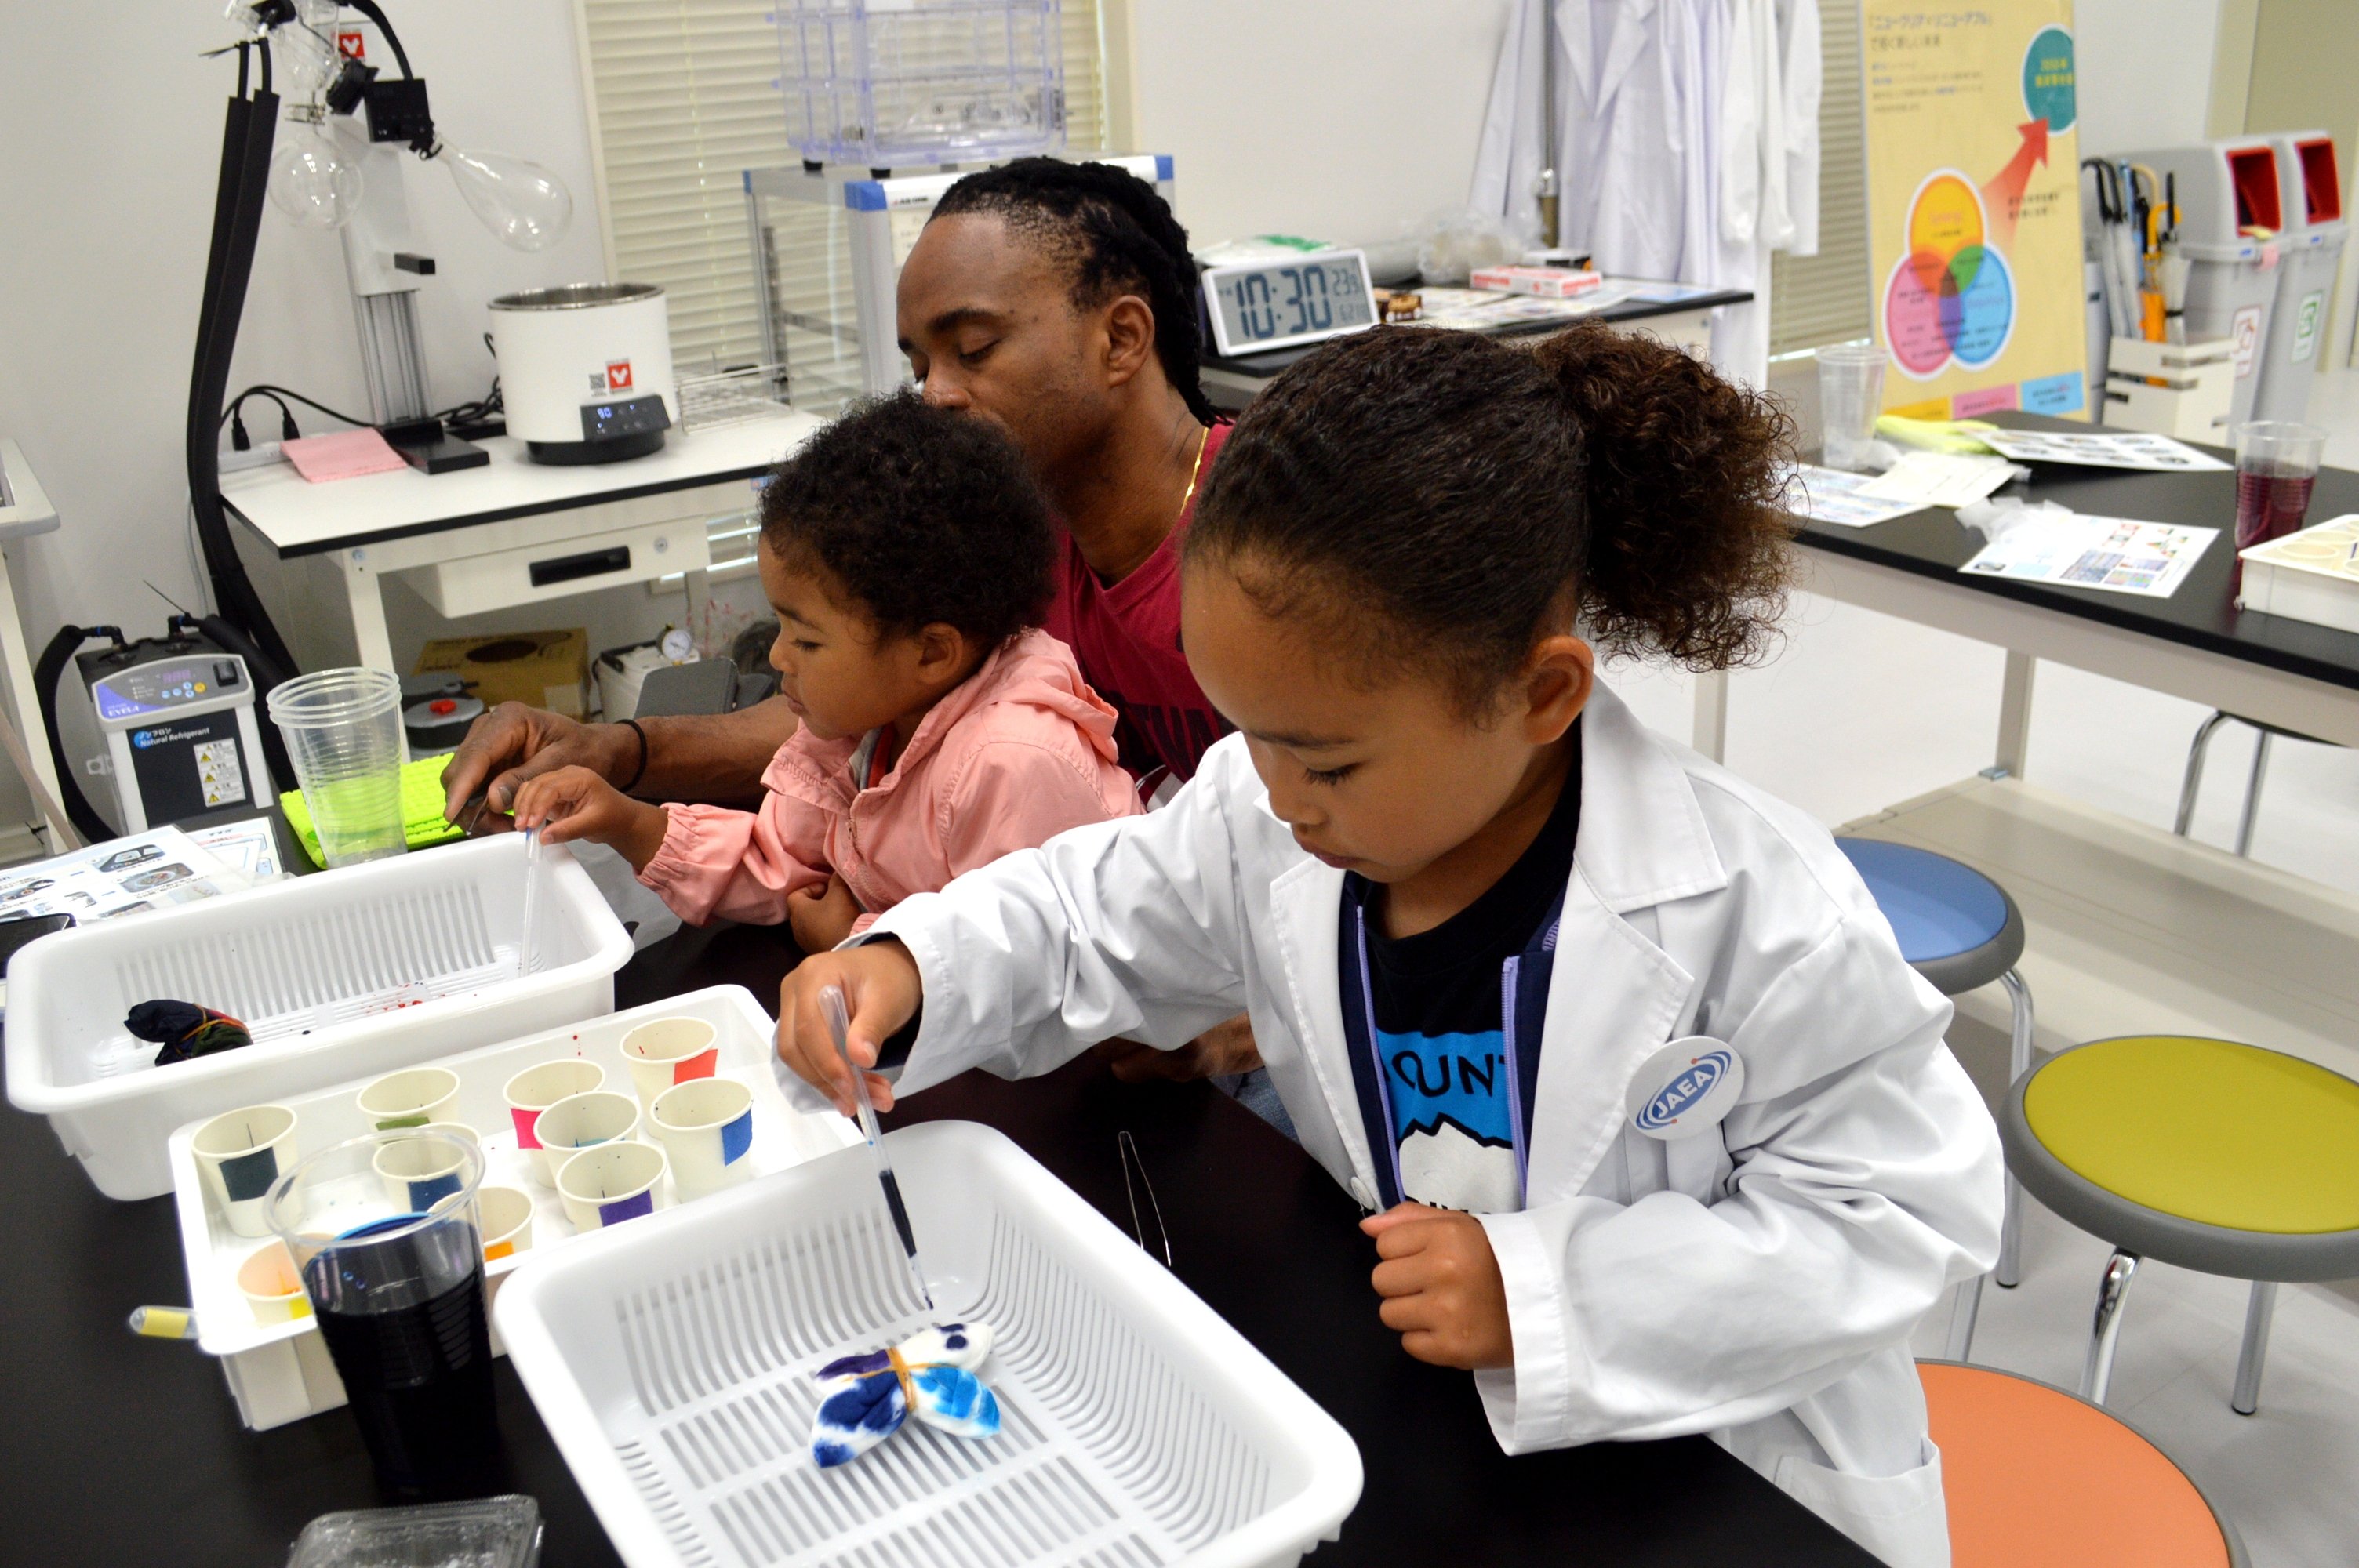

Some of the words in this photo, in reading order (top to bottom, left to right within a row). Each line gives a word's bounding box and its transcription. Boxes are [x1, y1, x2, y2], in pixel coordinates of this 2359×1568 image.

[1236, 264, 1332, 339] 10:30
[140, 736, 168, 747] Natural
[169, 728, 209, 742] Refrigerant
[1381, 1051, 1505, 1098] OUN
[1656, 1070, 1713, 1118] JAEA
